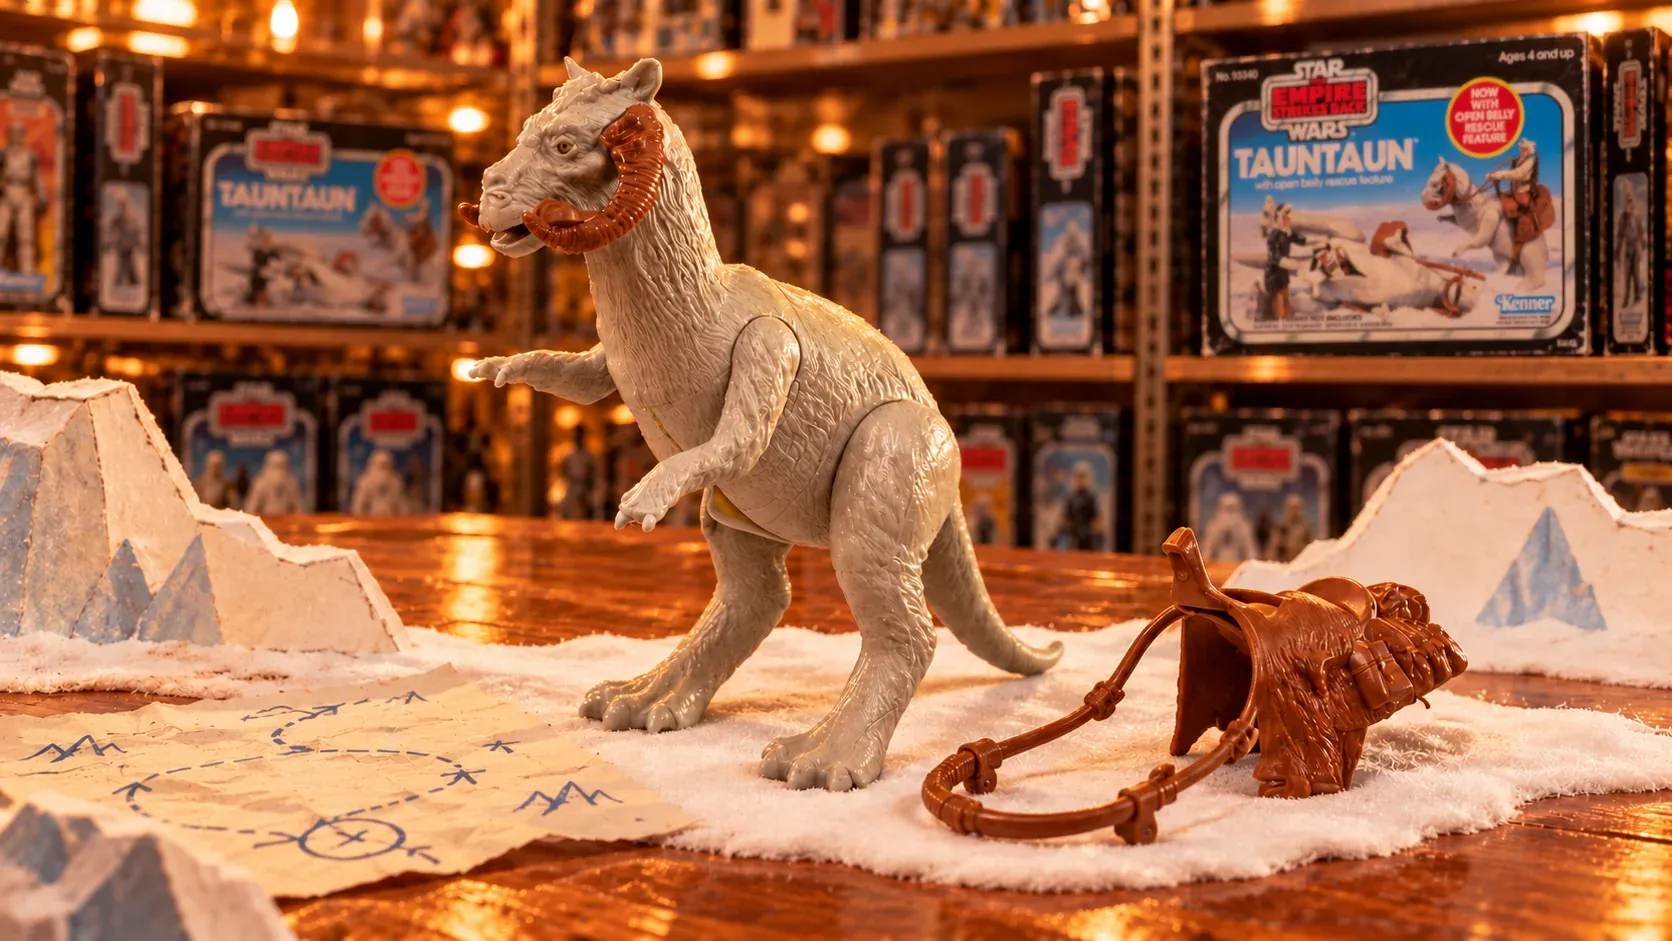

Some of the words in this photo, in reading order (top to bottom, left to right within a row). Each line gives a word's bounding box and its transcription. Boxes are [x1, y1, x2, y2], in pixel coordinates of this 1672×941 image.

[1499, 51, 1526, 64] Ages
[1527, 50, 1535, 60] 4
[1536, 49, 1558, 60] and
[1560, 48, 1575, 61] up
[1294, 58, 1344, 79] STAR
[1272, 81, 1367, 106] EMPIRE
[1471, 87, 1499, 99] NOW
[1272, 104, 1328, 119] STRIKES
[1330, 101, 1367, 115] BACK
[1471, 99, 1499, 110] WITH
[1455, 111, 1485, 123] OPEN
[1486, 109, 1516, 121] BELLY
[1287, 121, 1348, 140] WARS
[1464, 120, 1506, 133] RESCUE
[1462, 132, 1507, 144] FEATURE
[1255, 179, 1273, 190] with
[1274, 180, 1299, 190] open
[1300, 178, 1323, 188] belly
[1325, 176, 1357, 187] rescue
[1359, 174, 1394, 185] feature
[218, 180, 357, 212] TAUNTAUN
[1497, 295, 1555, 311] Kenner
